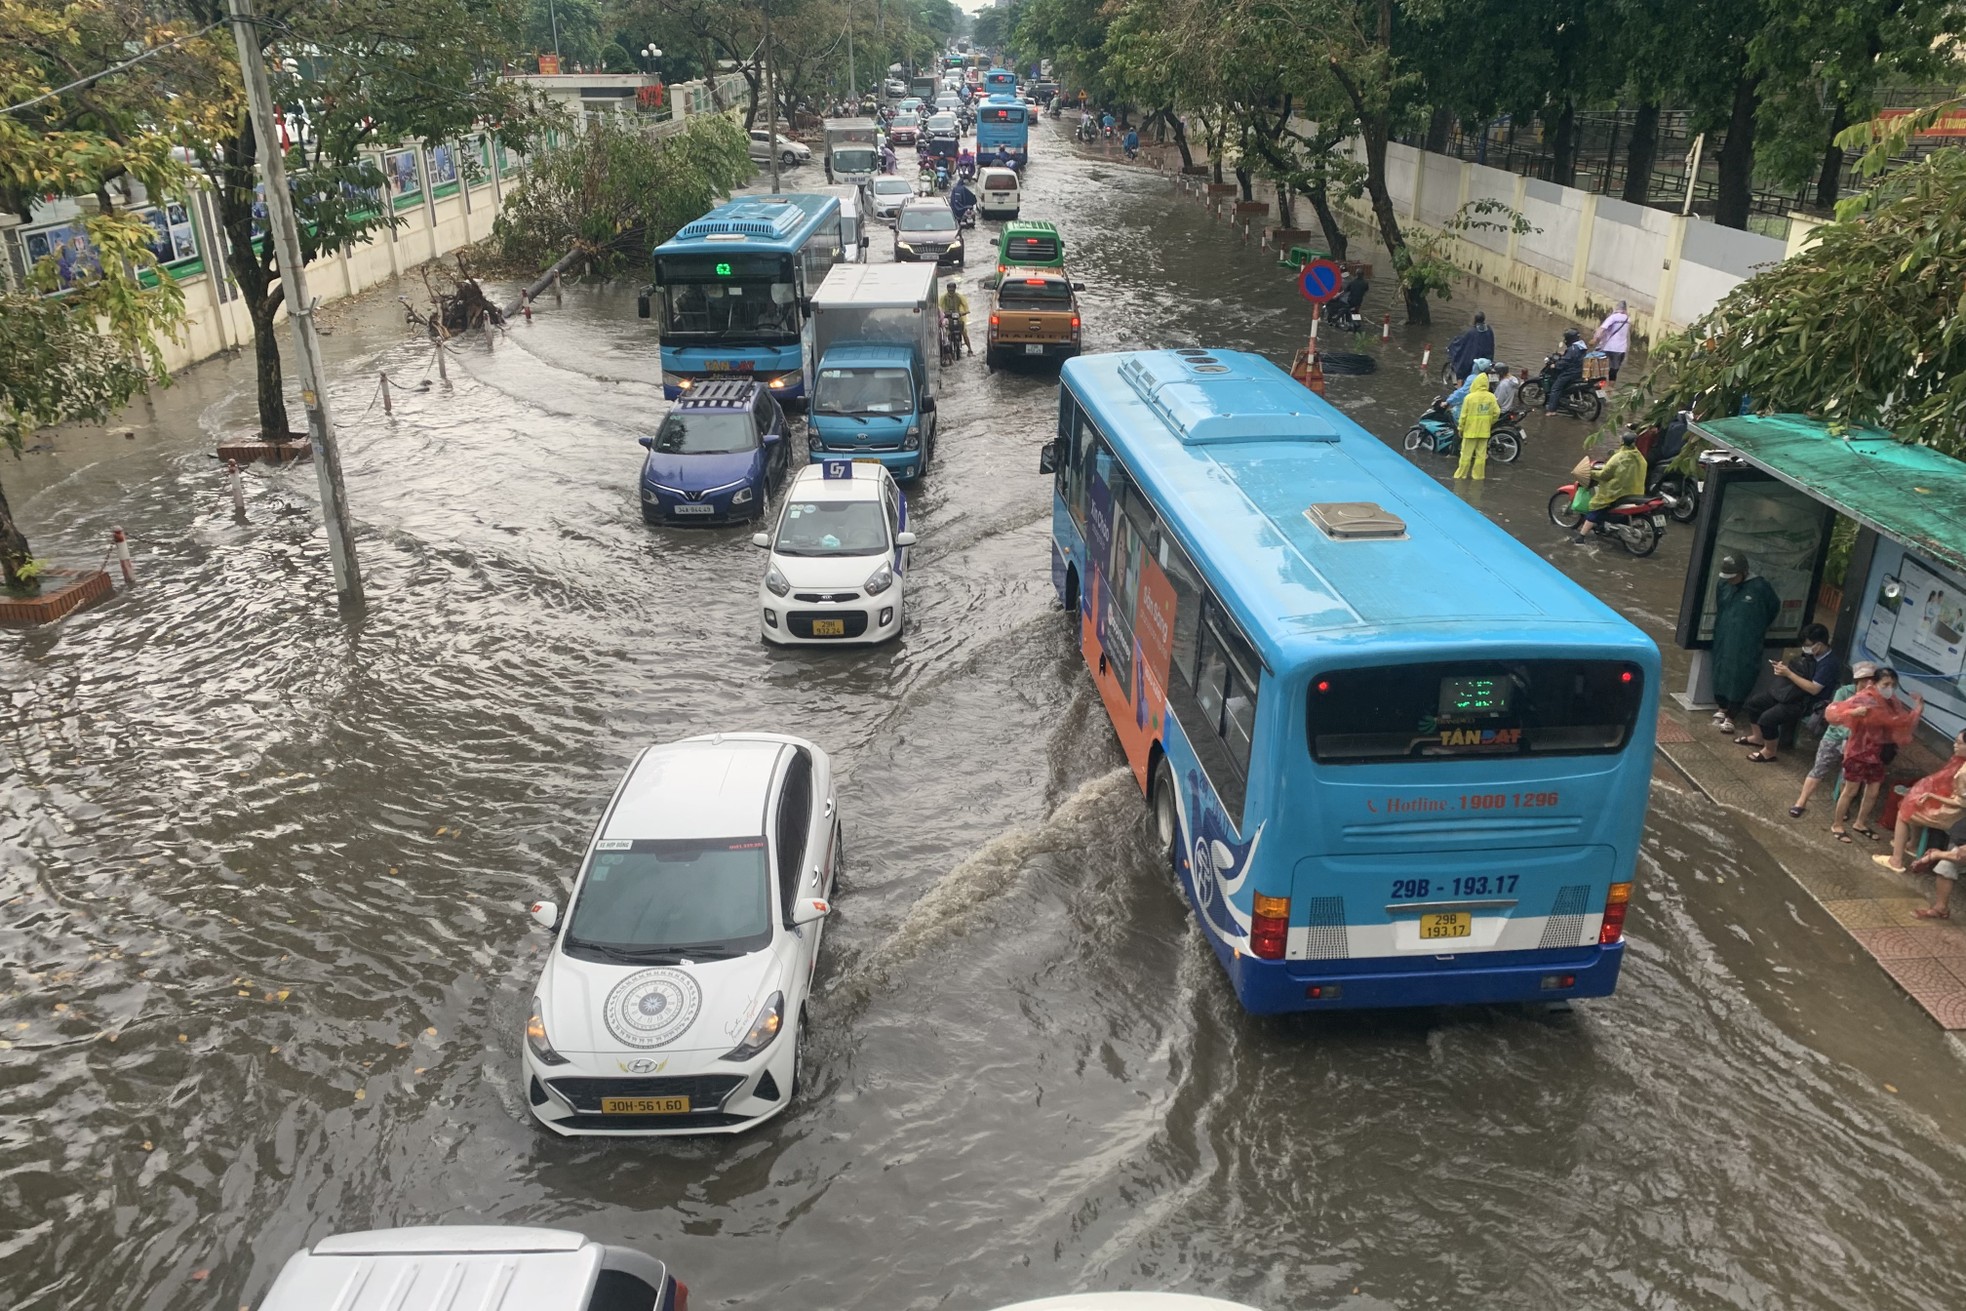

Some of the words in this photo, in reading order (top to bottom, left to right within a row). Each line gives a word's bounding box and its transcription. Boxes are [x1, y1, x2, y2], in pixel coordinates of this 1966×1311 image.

[1459, 794, 1506, 810] 1900
[1512, 791, 1559, 808] 1296
[1391, 879, 1430, 899] 29B
[1453, 875, 1520, 896] 193.17
[1434, 914, 1457, 926] 29B
[1427, 925, 1466, 938] 193.17
[609, 1099, 682, 1112] 30H-561.60
